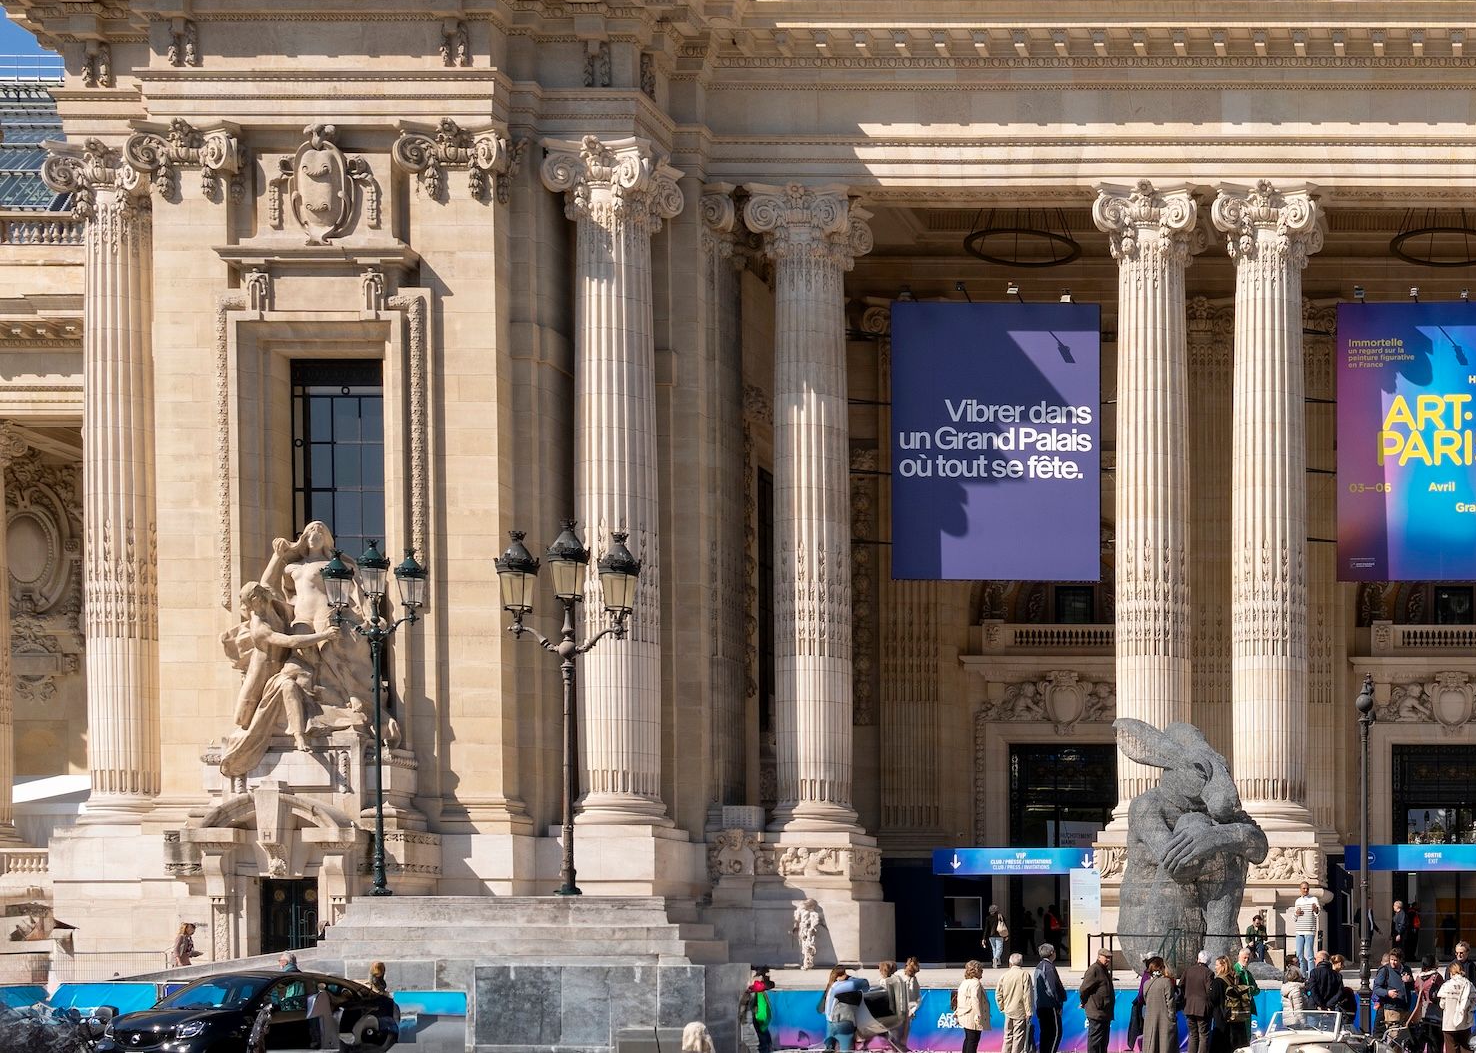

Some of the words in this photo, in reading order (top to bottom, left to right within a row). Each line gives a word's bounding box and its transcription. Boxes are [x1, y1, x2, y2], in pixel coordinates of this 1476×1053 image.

[1348, 338, 1403, 347] Immortelle
[945, 399, 1024, 422] Vibrer
[1028, 400, 1092, 424] dans
[900, 431, 931, 450] un
[934, 426, 1014, 450] Grand
[1019, 428, 1092, 452] Palais
[900, 454, 932, 478] où
[936, 455, 988, 478] tout
[992, 460, 1023, 478] se
[1028, 456, 1084, 479] fête.
[1428, 482, 1456, 492] Avril
[263, 832, 271, 840] H
